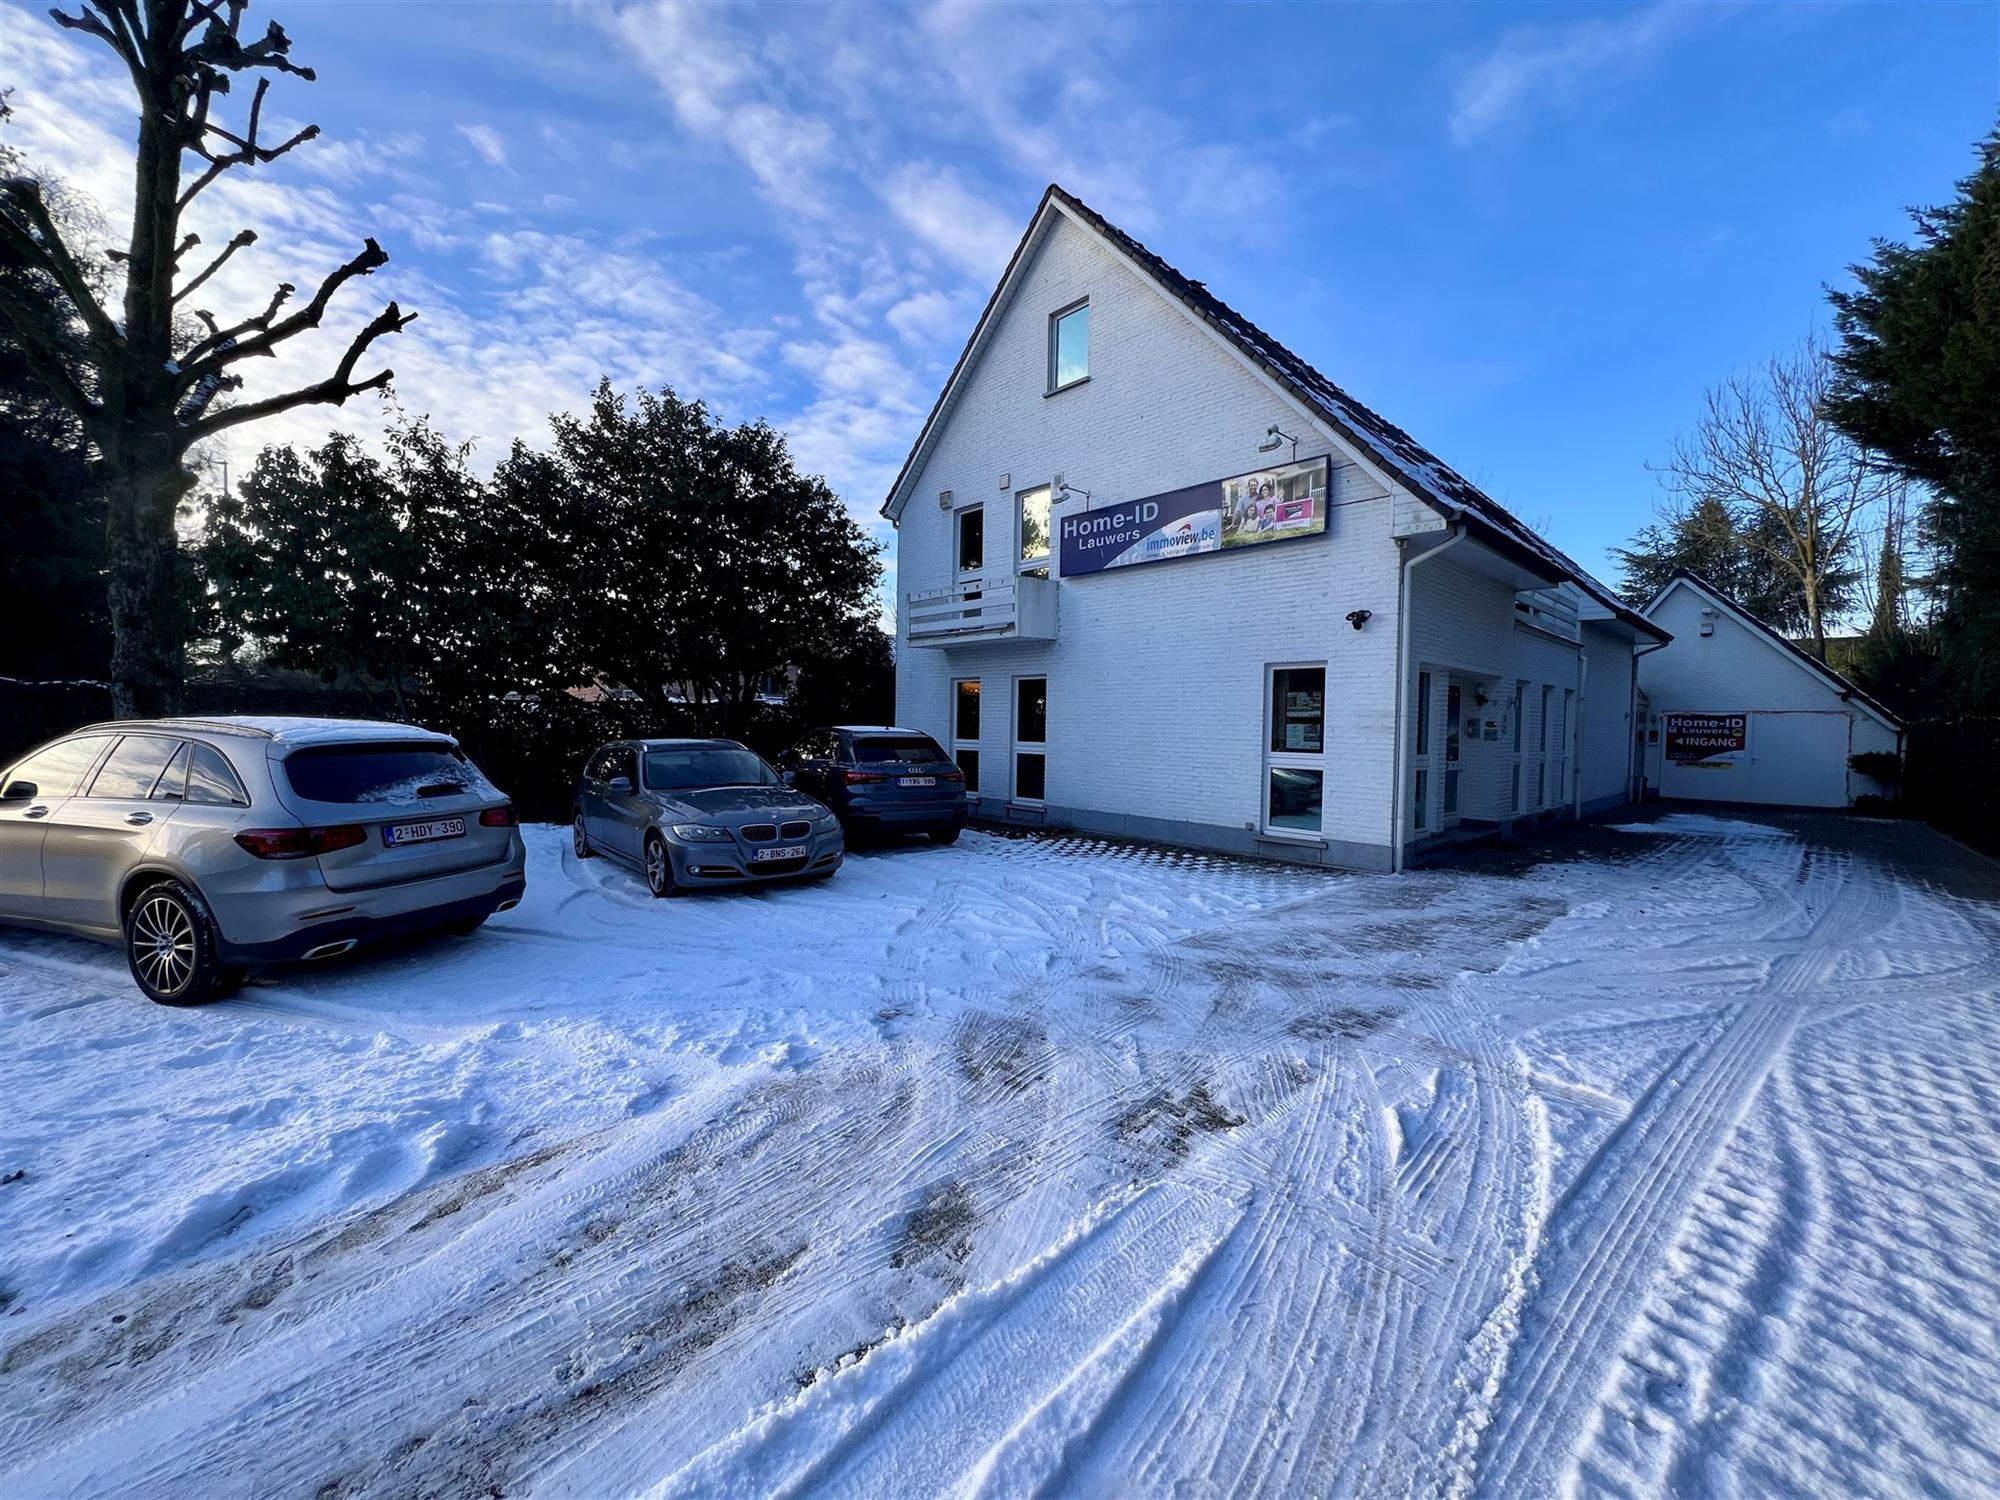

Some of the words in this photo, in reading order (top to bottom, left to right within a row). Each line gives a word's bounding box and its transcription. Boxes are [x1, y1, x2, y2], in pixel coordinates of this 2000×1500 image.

[1063, 501, 1159, 539] Home-ID
[1078, 528, 1141, 550] Lauwers
[1146, 527, 1215, 551] immoview.be
[1671, 717, 1744, 728] Home-ID
[1685, 737, 1737, 747] INGANG
